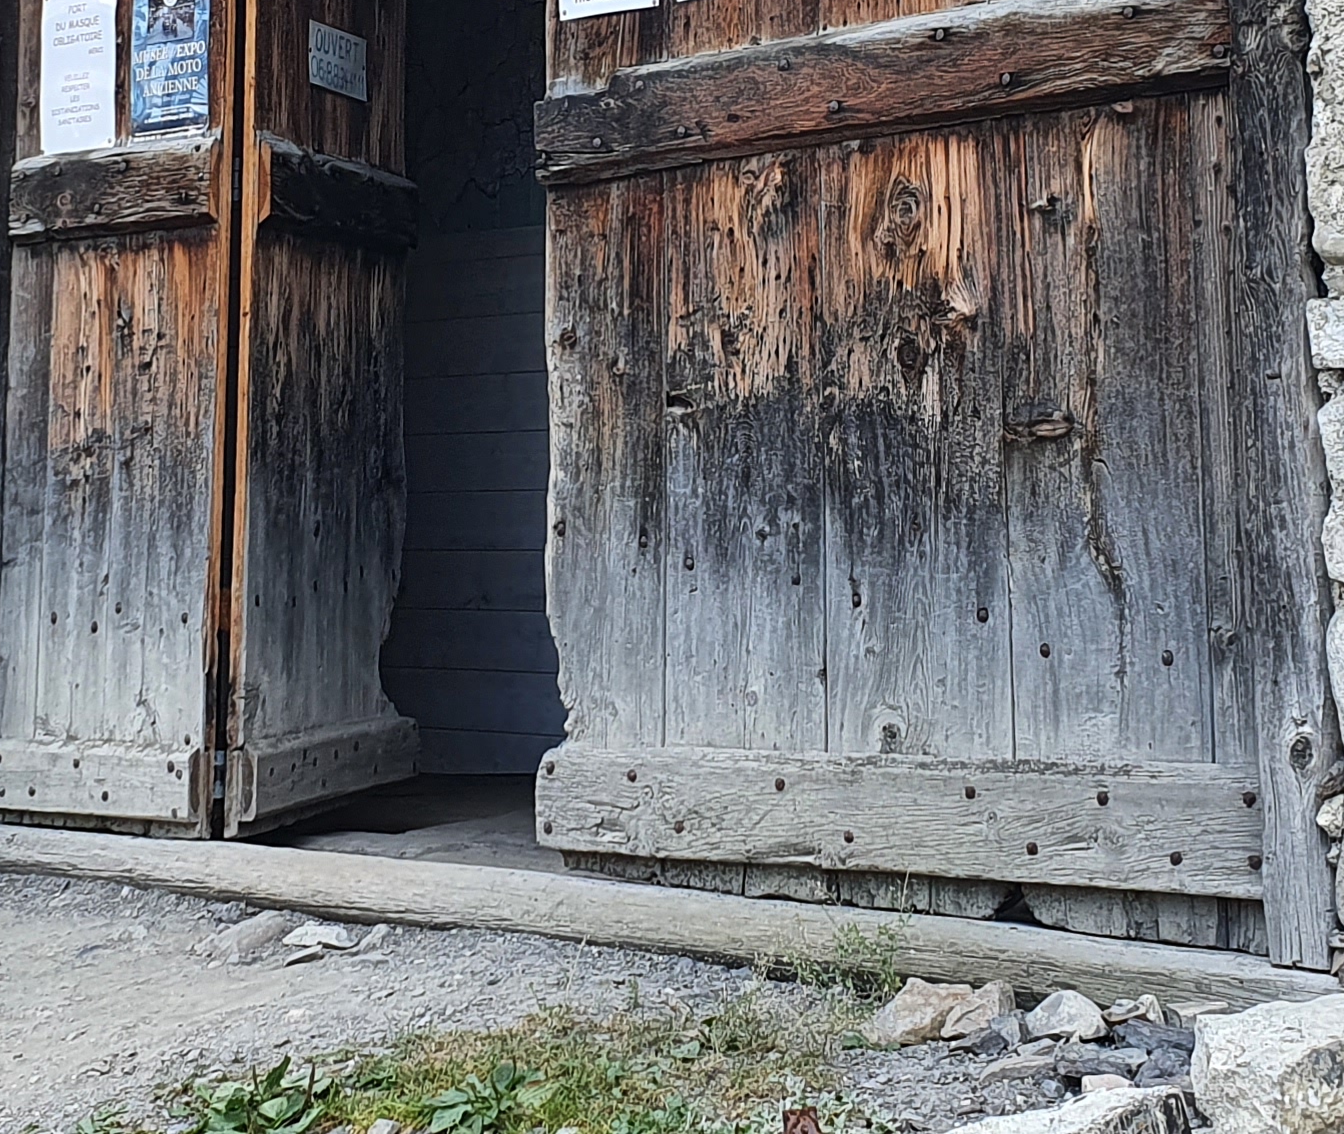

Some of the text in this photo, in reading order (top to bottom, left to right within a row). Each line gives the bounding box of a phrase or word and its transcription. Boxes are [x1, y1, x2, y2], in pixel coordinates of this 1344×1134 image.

[176, 40, 206, 58] EXPO
[315, 28, 360, 63] OUVERT
[136, 66, 150, 82] DE
[168, 58, 202, 76] MOTO
[143, 76, 200, 98] ANCIENNE
